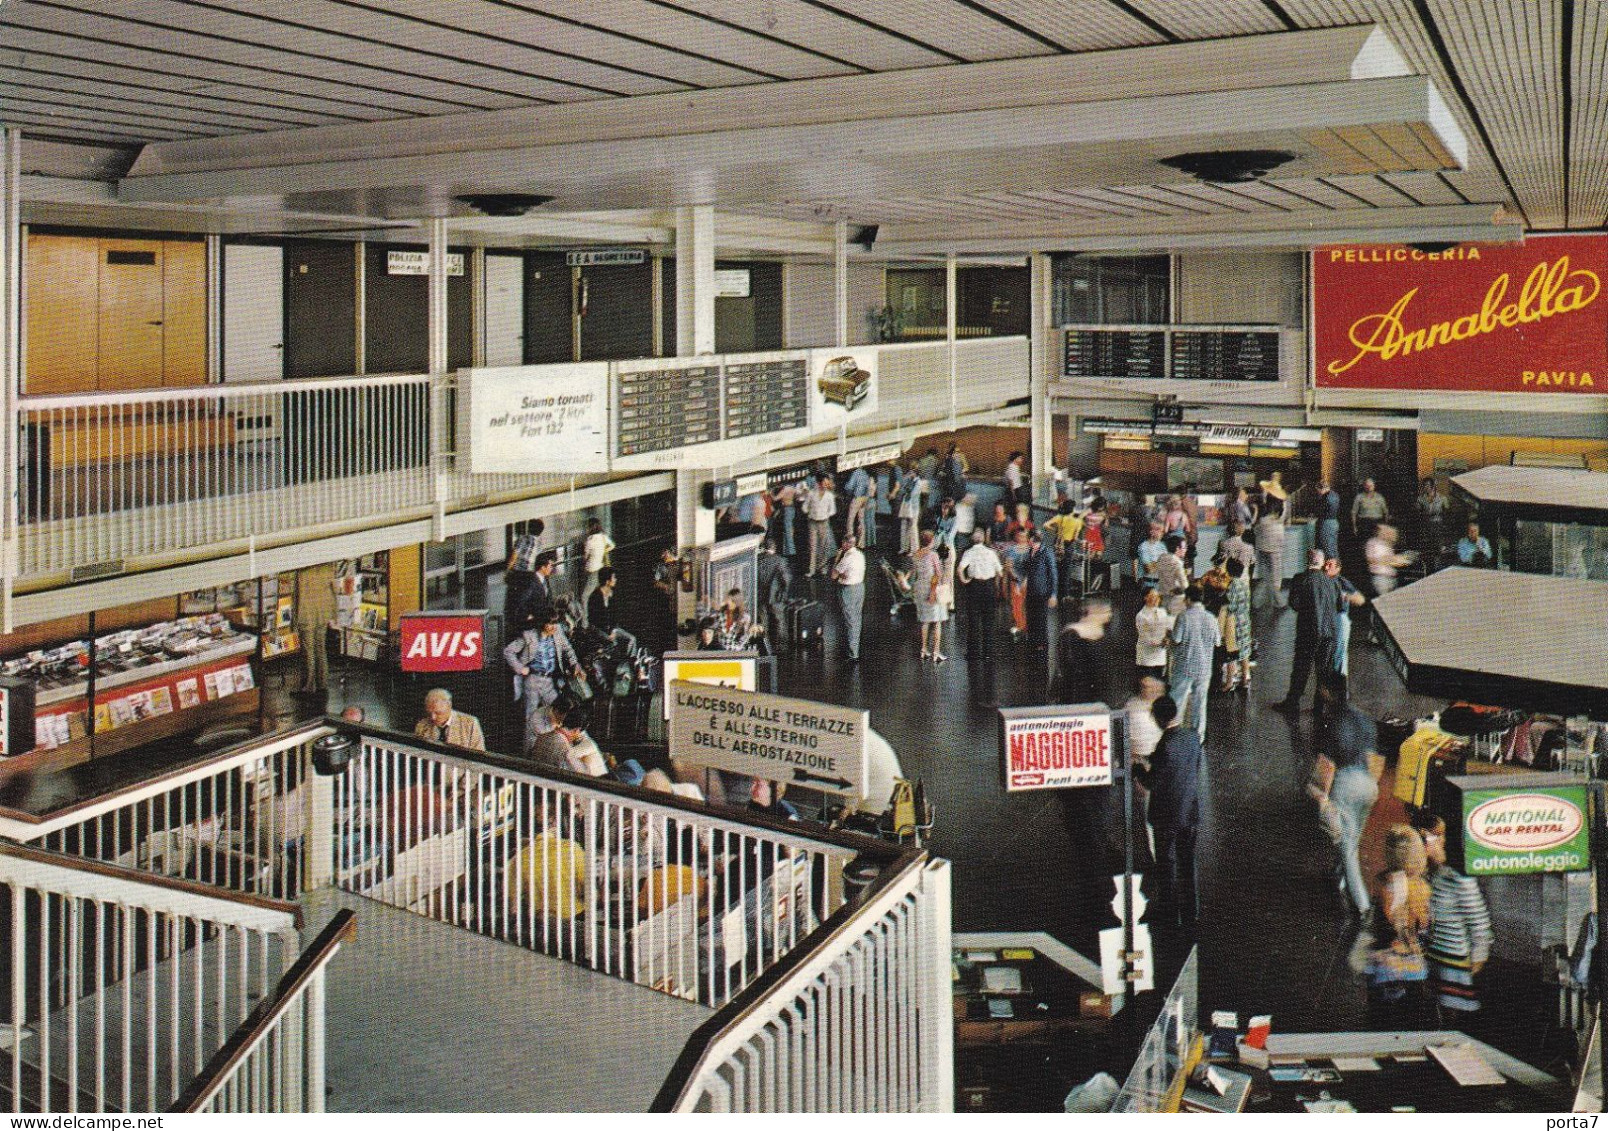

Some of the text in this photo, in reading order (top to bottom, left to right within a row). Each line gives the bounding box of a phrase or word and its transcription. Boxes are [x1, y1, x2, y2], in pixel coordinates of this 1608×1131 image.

[1327, 255, 1600, 374] Annabella
[1522, 371, 1594, 386] PAVIA
[521, 392, 593, 409] Siamo tornati
[489, 412, 509, 427] nel
[1212, 426, 1281, 438] INFORMAZIONI
[406, 631, 480, 658] AVIS
[676, 692, 855, 736] L'ACCESSO ALLE TERRAZZE
[1010, 719, 1084, 732] autonoleggio
[1010, 729, 1108, 772] MAGGIORE
[1484, 808, 1567, 824] NATIONAL
[1484, 824, 1564, 836] CAR RENTAL
[1472, 851, 1580, 871] autonoleggio
